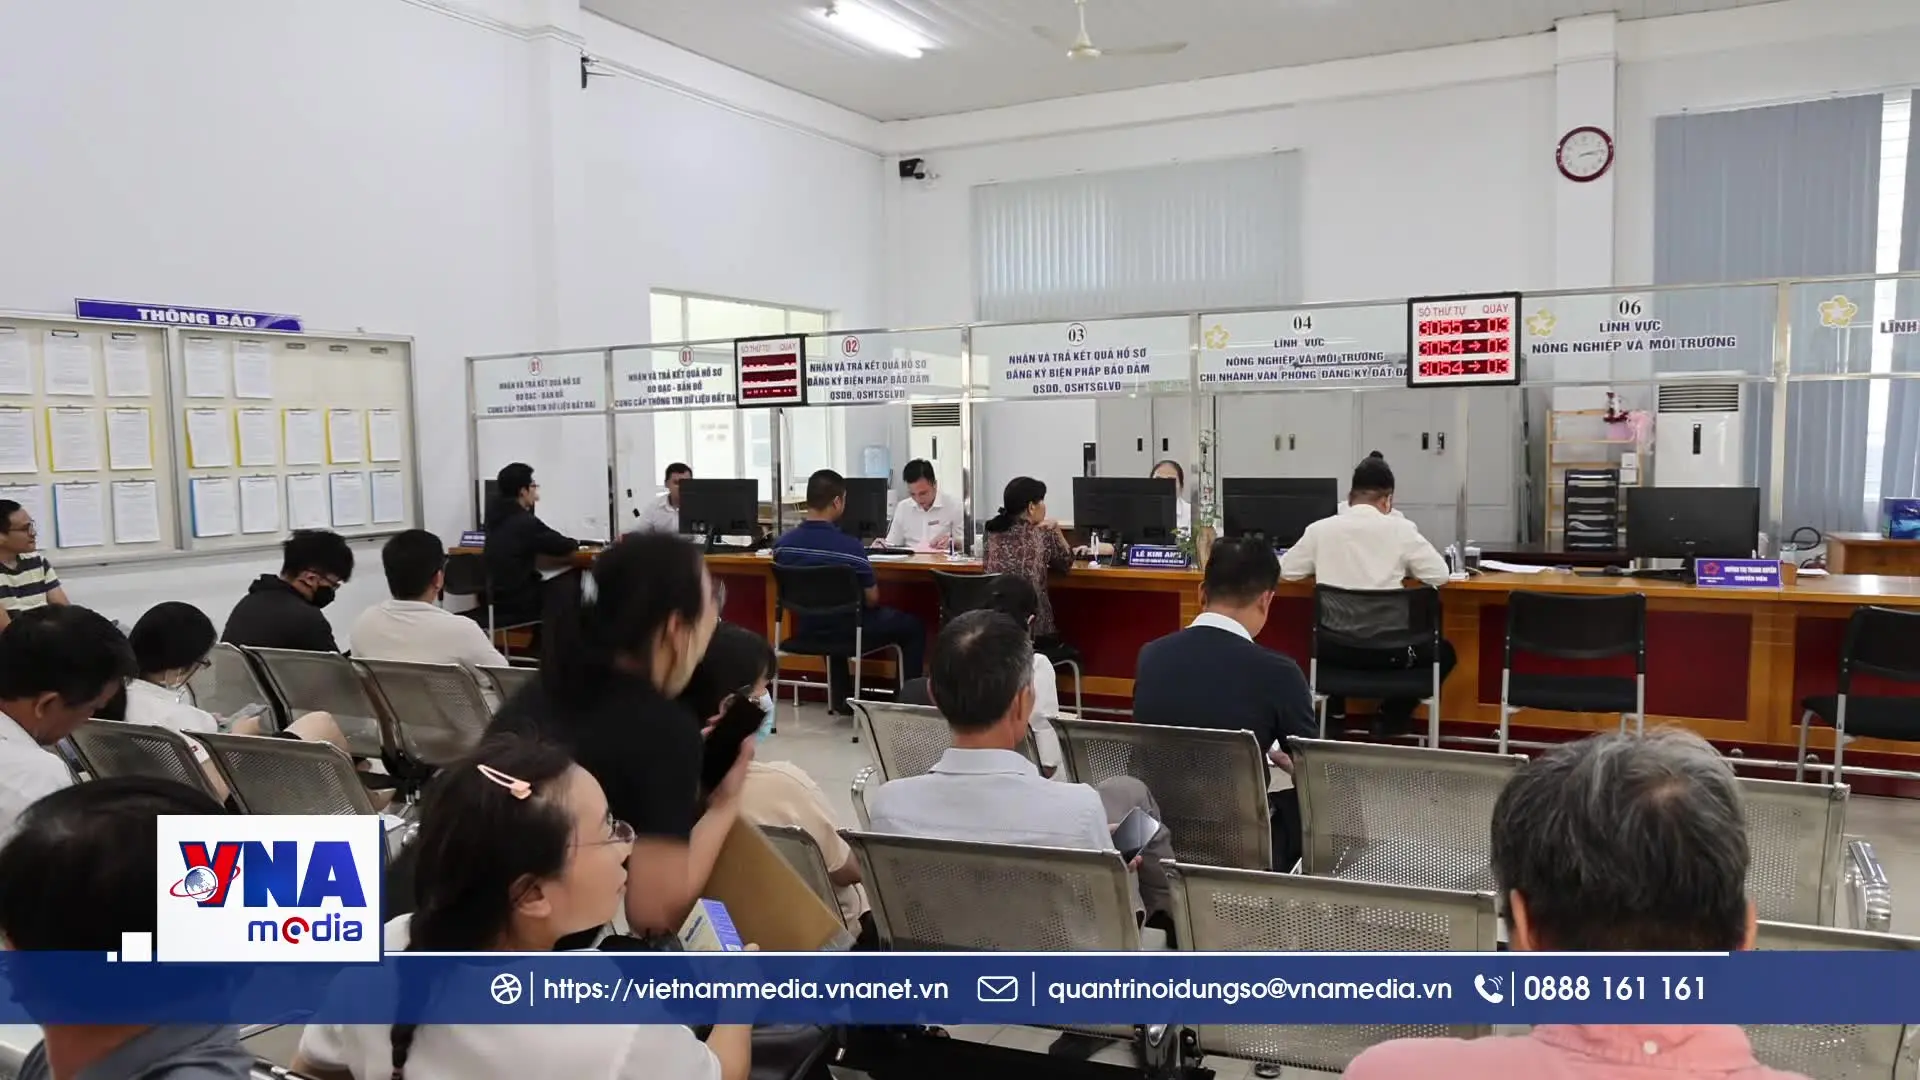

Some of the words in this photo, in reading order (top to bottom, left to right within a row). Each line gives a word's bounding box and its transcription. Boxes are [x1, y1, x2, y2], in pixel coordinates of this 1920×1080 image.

[1619, 299, 1641, 315] 06
[136, 308, 210, 325] THÔNG
[215, 314, 256, 327] BÁO
[1293, 316, 1313, 330] 04
[1419, 319, 1462, 336] 3055
[1487, 317, 1510, 333] 03
[1068, 328, 1085, 342] 03
[846, 341, 857, 353] 02
[1419, 340, 1464, 356] 3054
[1487, 337, 1510, 354] 03
[1532, 341, 1569, 354] NÔNG
[1650, 337, 1675, 349] MÔI
[682, 350, 692, 362] 01
[1419, 360, 1464, 377] 3054
[1487, 358, 1510, 374] 03
[1200, 373, 1216, 382] CHI
